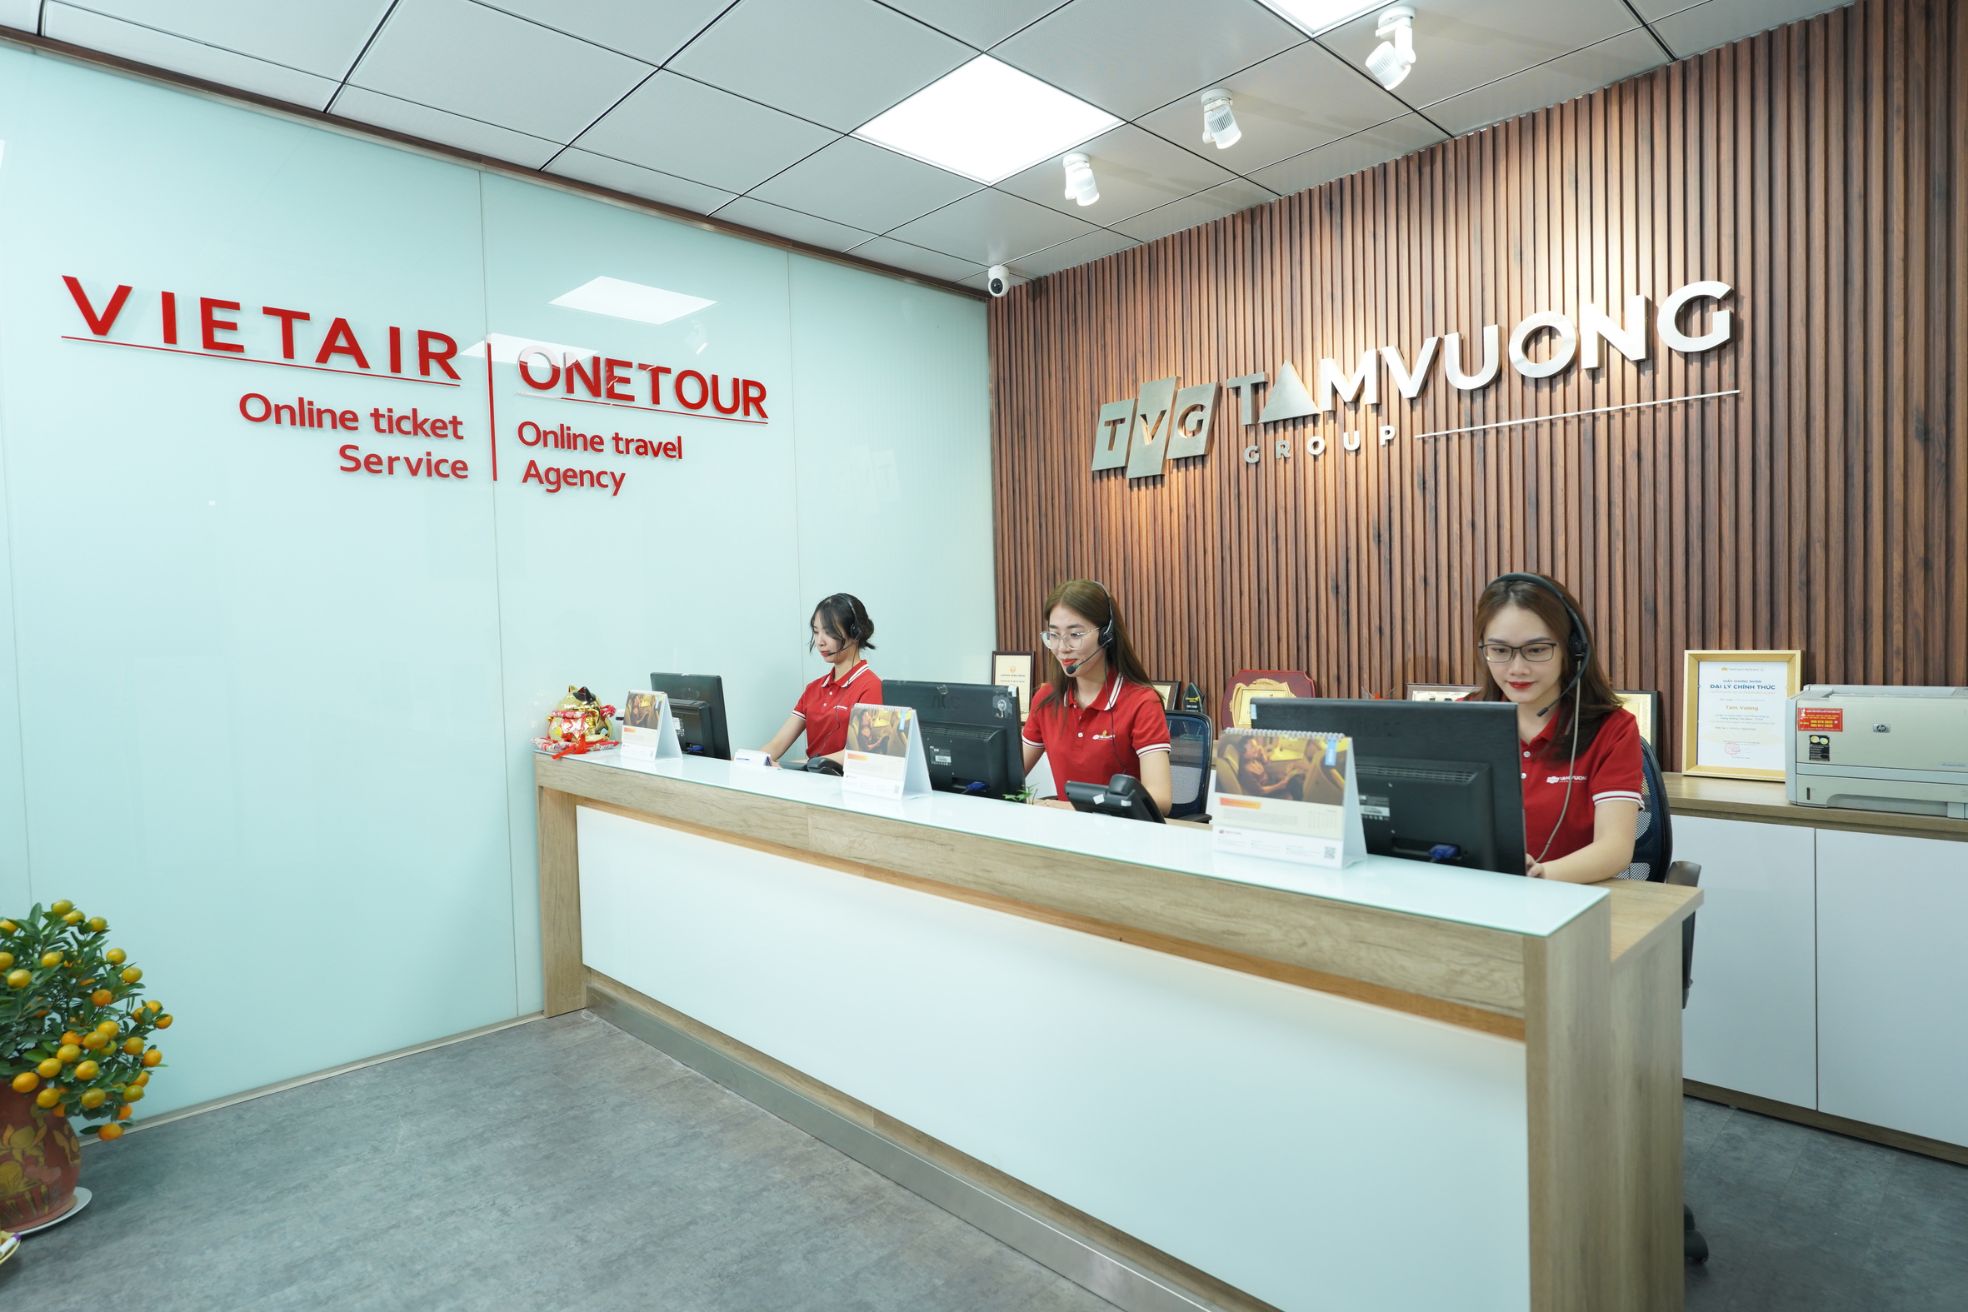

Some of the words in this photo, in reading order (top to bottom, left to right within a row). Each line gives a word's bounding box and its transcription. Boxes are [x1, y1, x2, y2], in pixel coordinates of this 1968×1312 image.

[61, 275, 462, 380] VIETAIR
[1227, 280, 1735, 426] TAMVUONG
[517, 346, 769, 419] ONETOUR
[239, 393, 359, 431] Online
[370, 408, 464, 440] ticket
[338, 444, 469, 479] Service
[517, 421, 604, 453] Online
[612, 432, 683, 460] travel
[1243, 425, 1396, 464] GROUP
[522, 460, 626, 497] Agency
